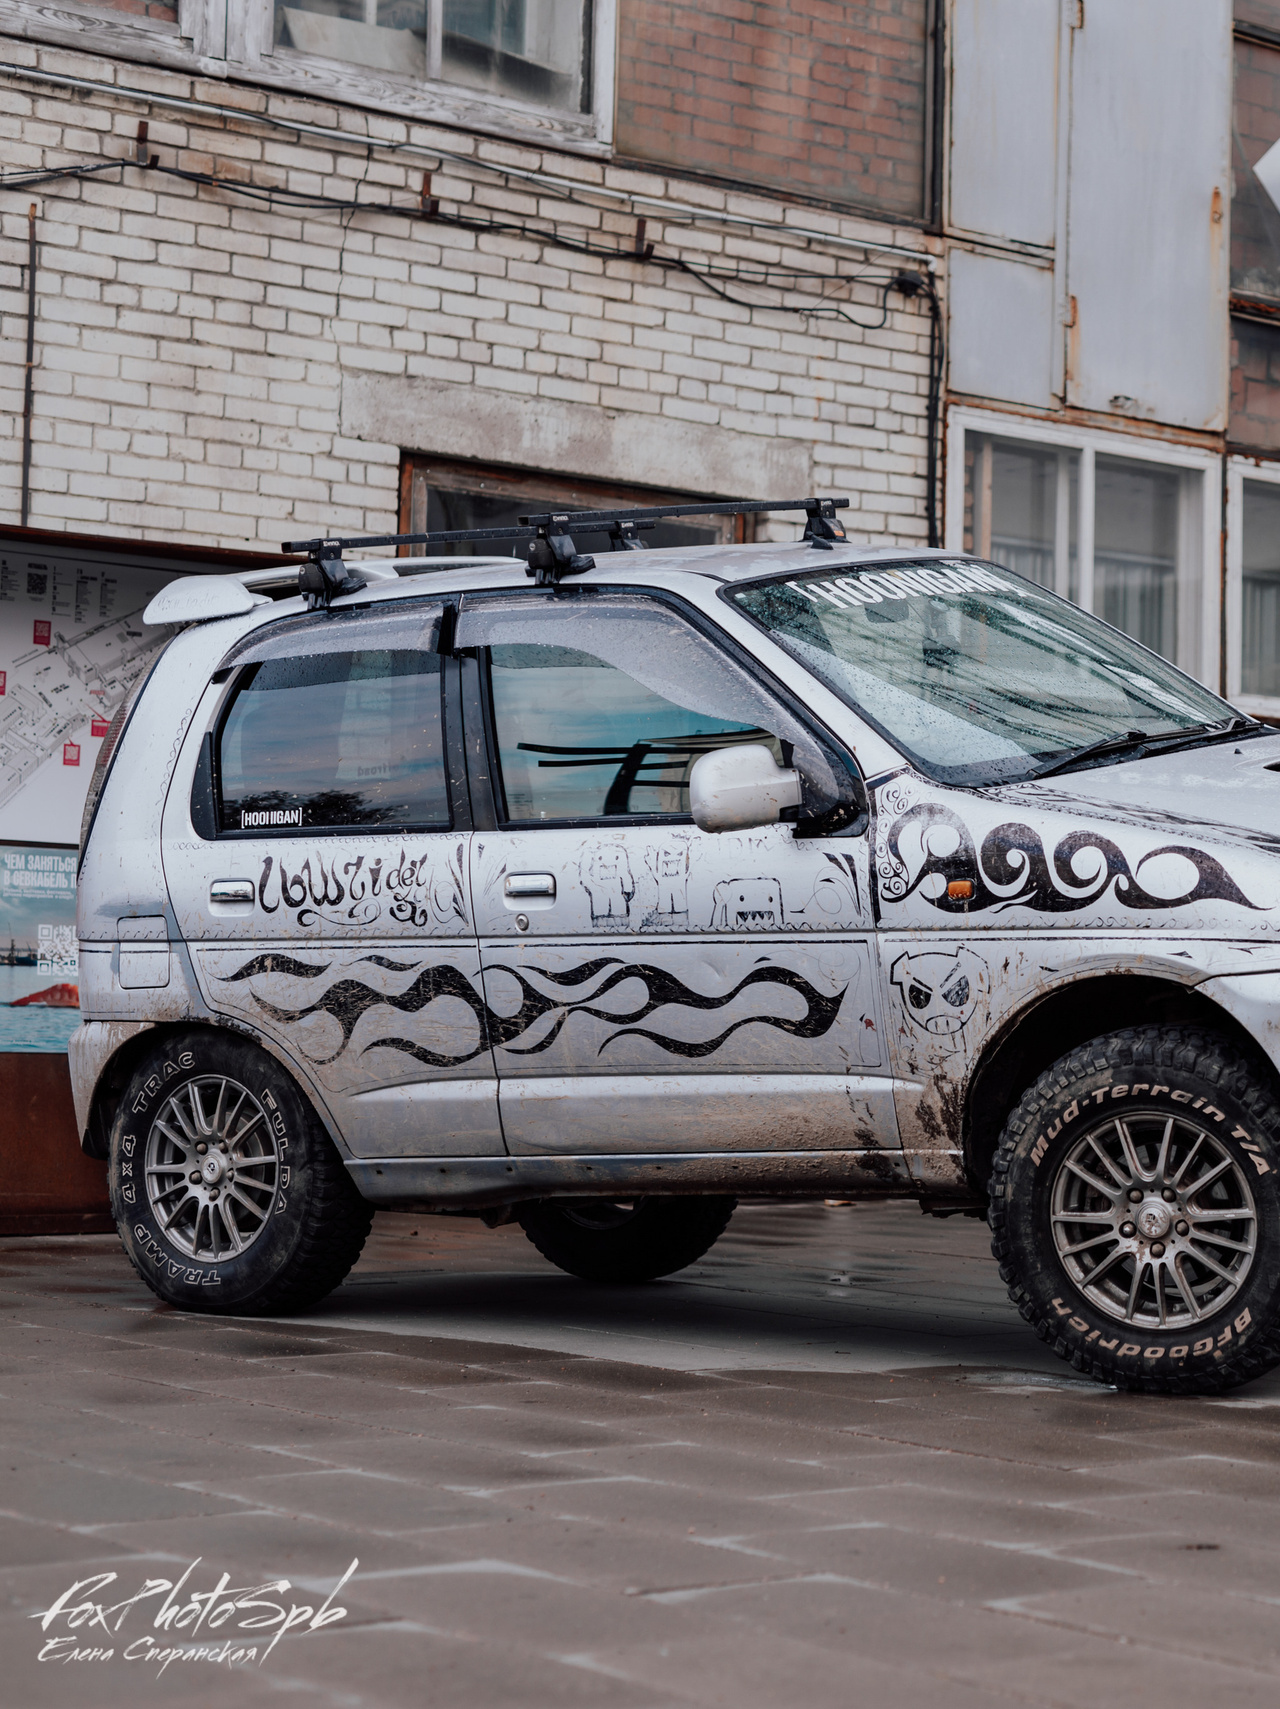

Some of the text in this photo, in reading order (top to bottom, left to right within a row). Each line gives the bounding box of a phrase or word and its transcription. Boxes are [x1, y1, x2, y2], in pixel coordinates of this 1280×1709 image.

[4, 854, 77, 872] ЧЕМ ЗАНЯТЬСЯ
[4, 870, 10, 885] В
[13, 871, 68, 888] СЕВКАБЕЛЬ
[132, 1051, 196, 1114] TRAC
[261, 1088, 291, 1215] FULDA
[1030, 1083, 1226, 1168] Mud-Terrain
[134, 1223, 221, 1286] TRAMP
[1052, 1298, 1252, 1359] BFGoodrich
